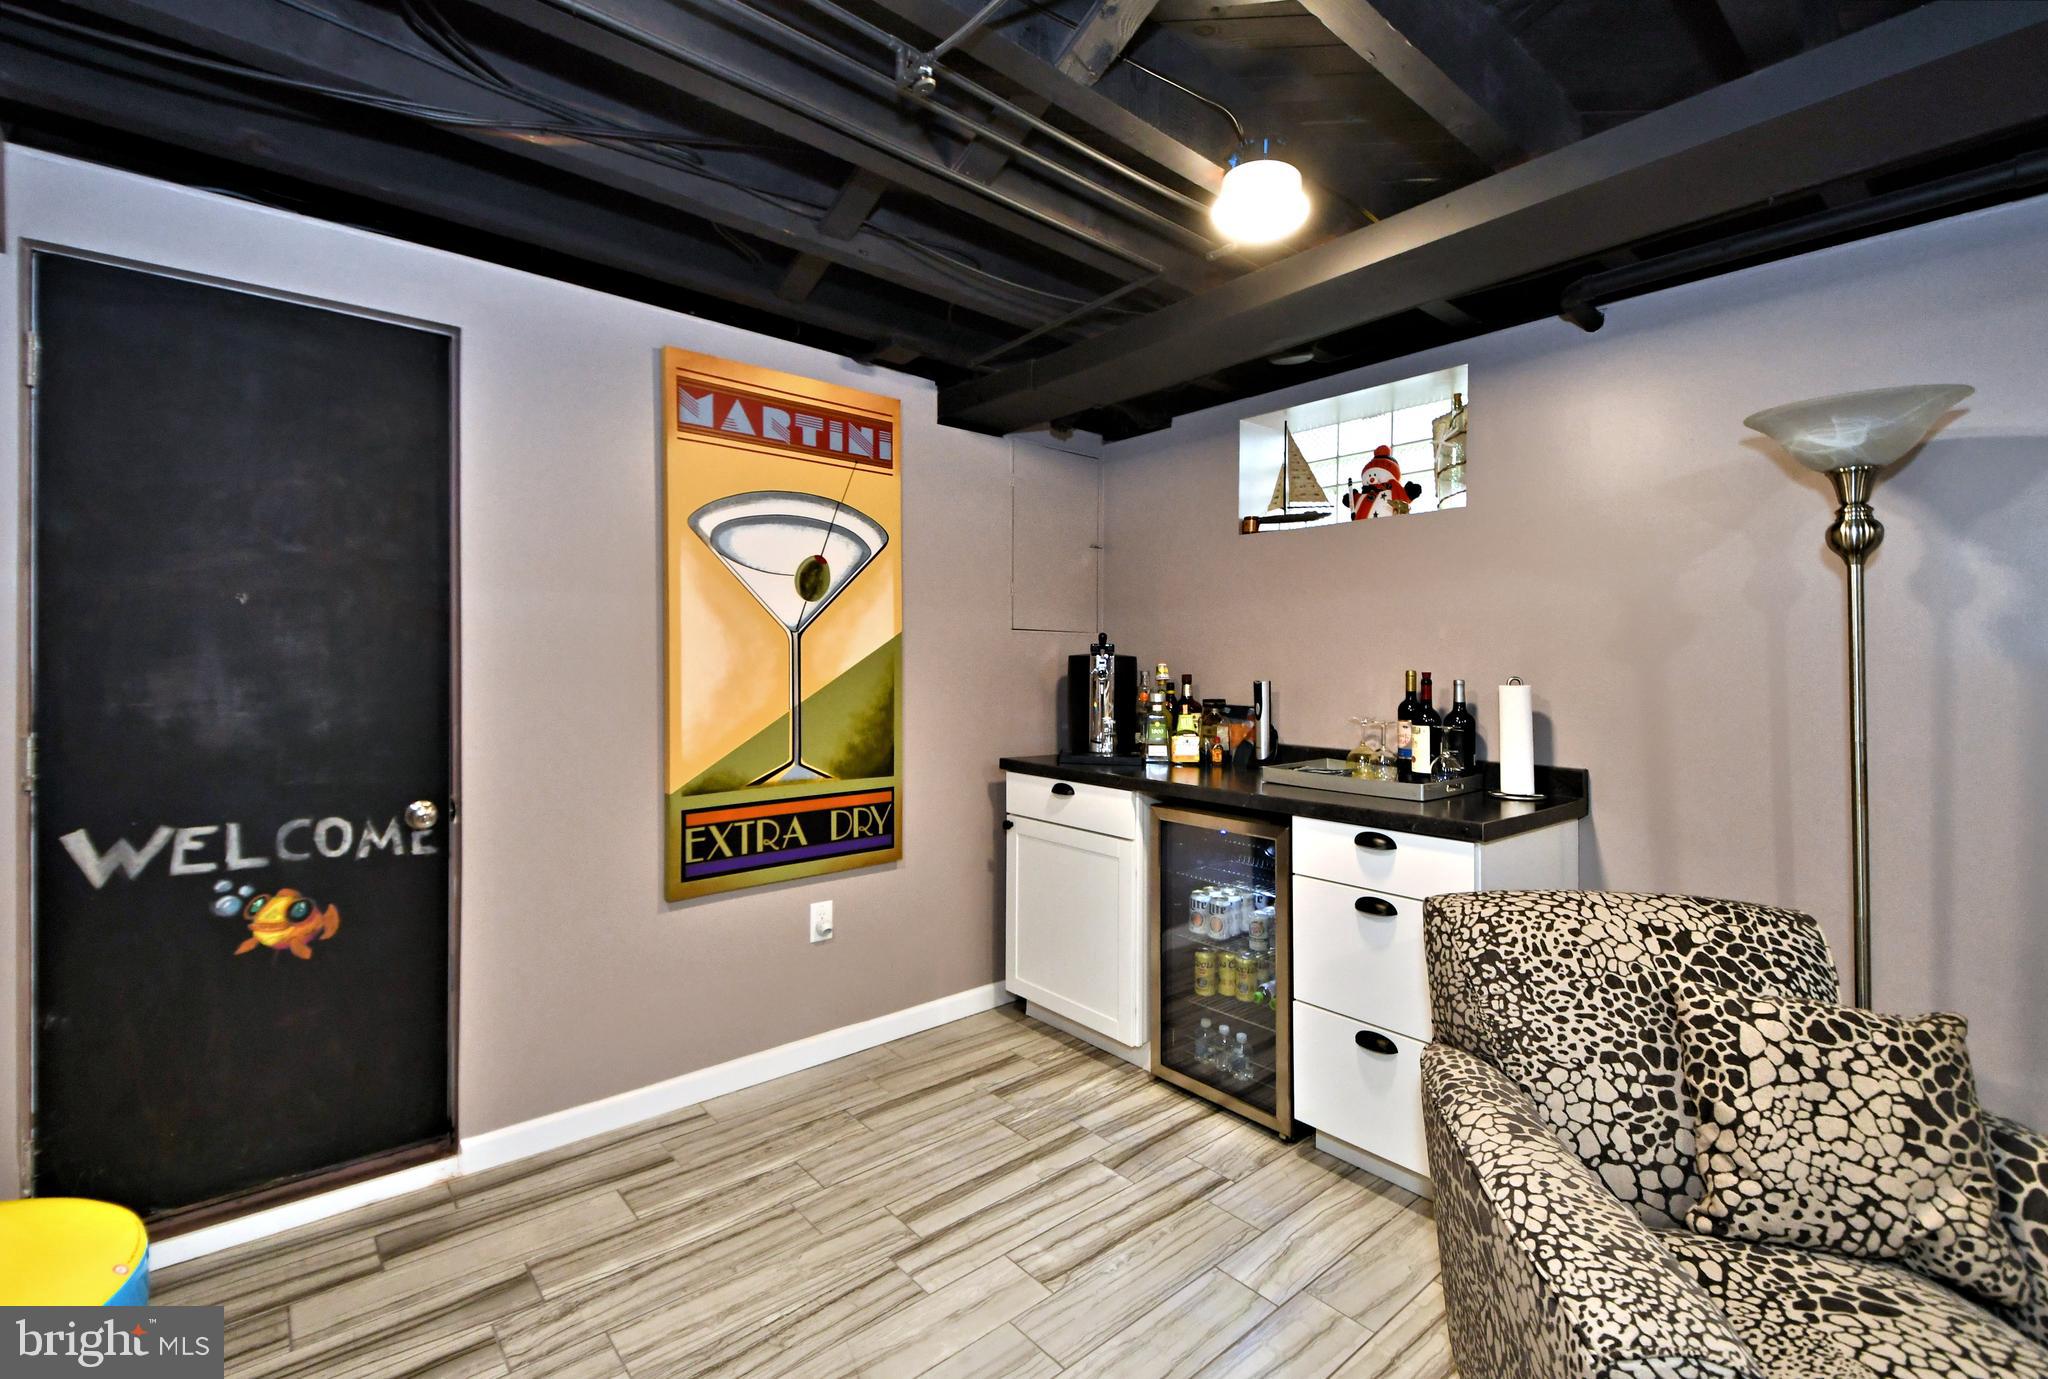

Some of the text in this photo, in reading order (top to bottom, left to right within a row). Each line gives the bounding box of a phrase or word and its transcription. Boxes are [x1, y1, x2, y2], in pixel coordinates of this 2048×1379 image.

[679, 386, 892, 459] MARTINI
[59, 815, 439, 889] WELCOME
[685, 804, 892, 863] EXTRA DRY
